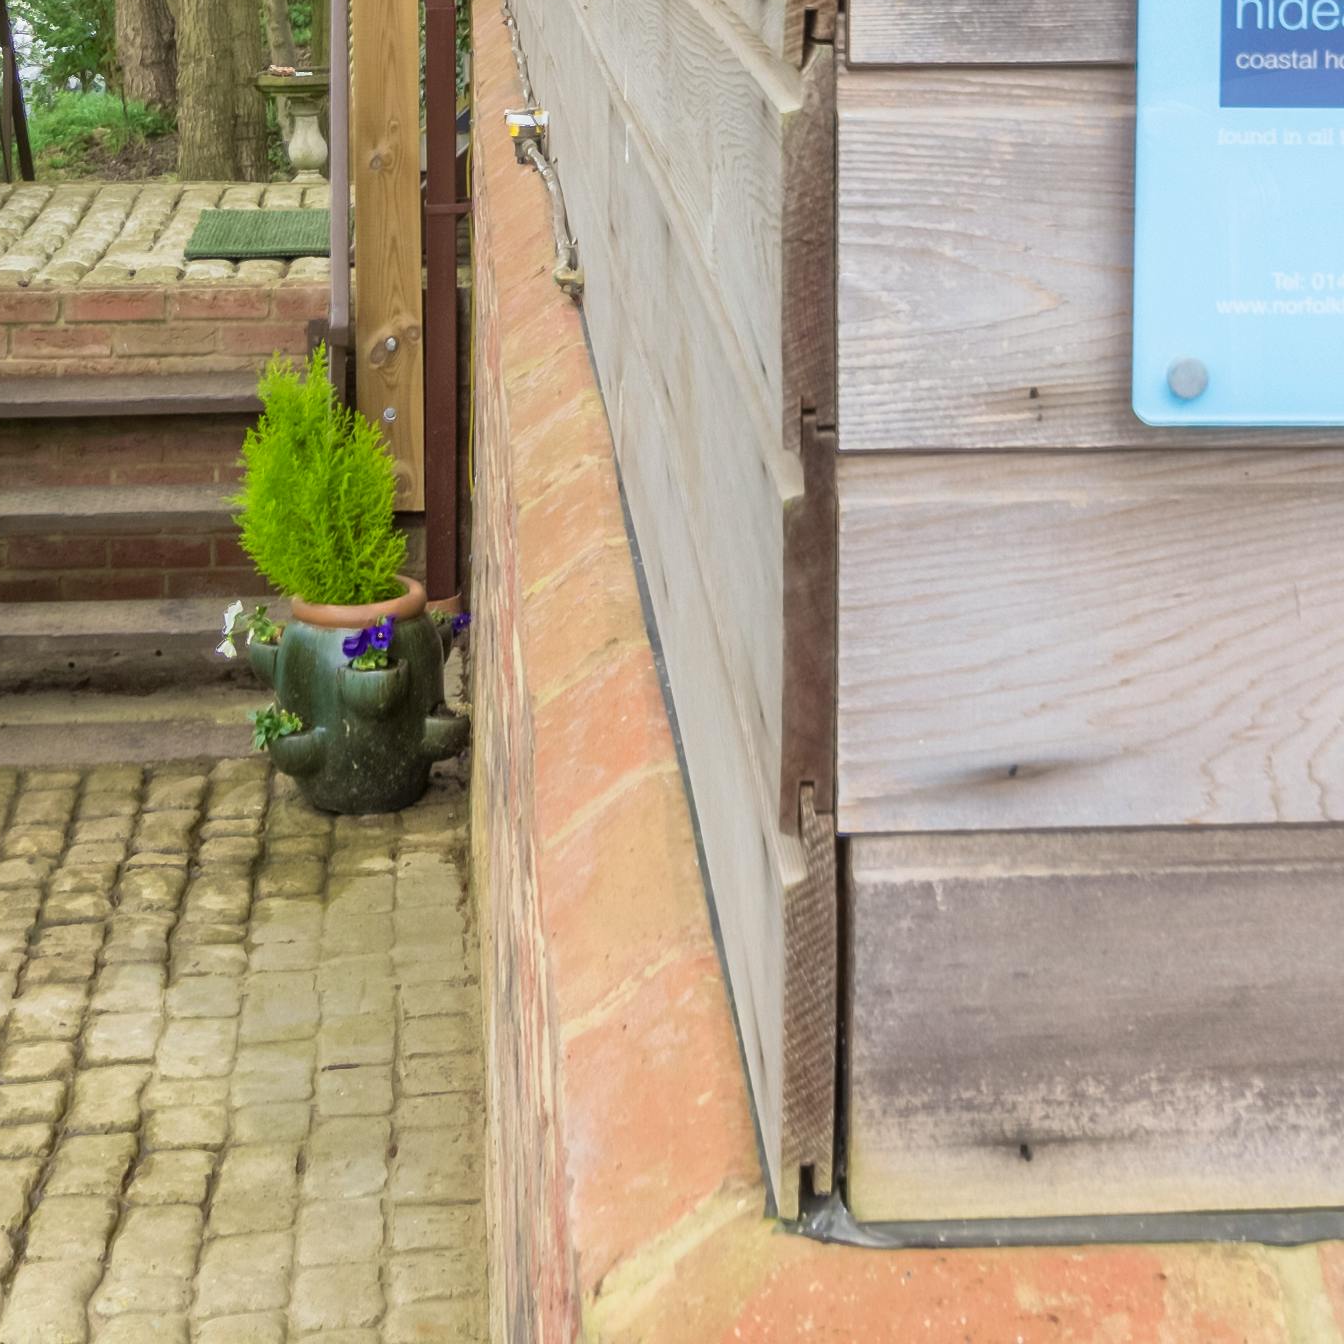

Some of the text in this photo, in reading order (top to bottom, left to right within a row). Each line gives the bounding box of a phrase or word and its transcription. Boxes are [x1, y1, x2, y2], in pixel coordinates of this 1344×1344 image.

[1235, 50, 1318, 71] coastal
[1216, 127, 1278, 146] found
[1282, 127, 1303, 146] in
